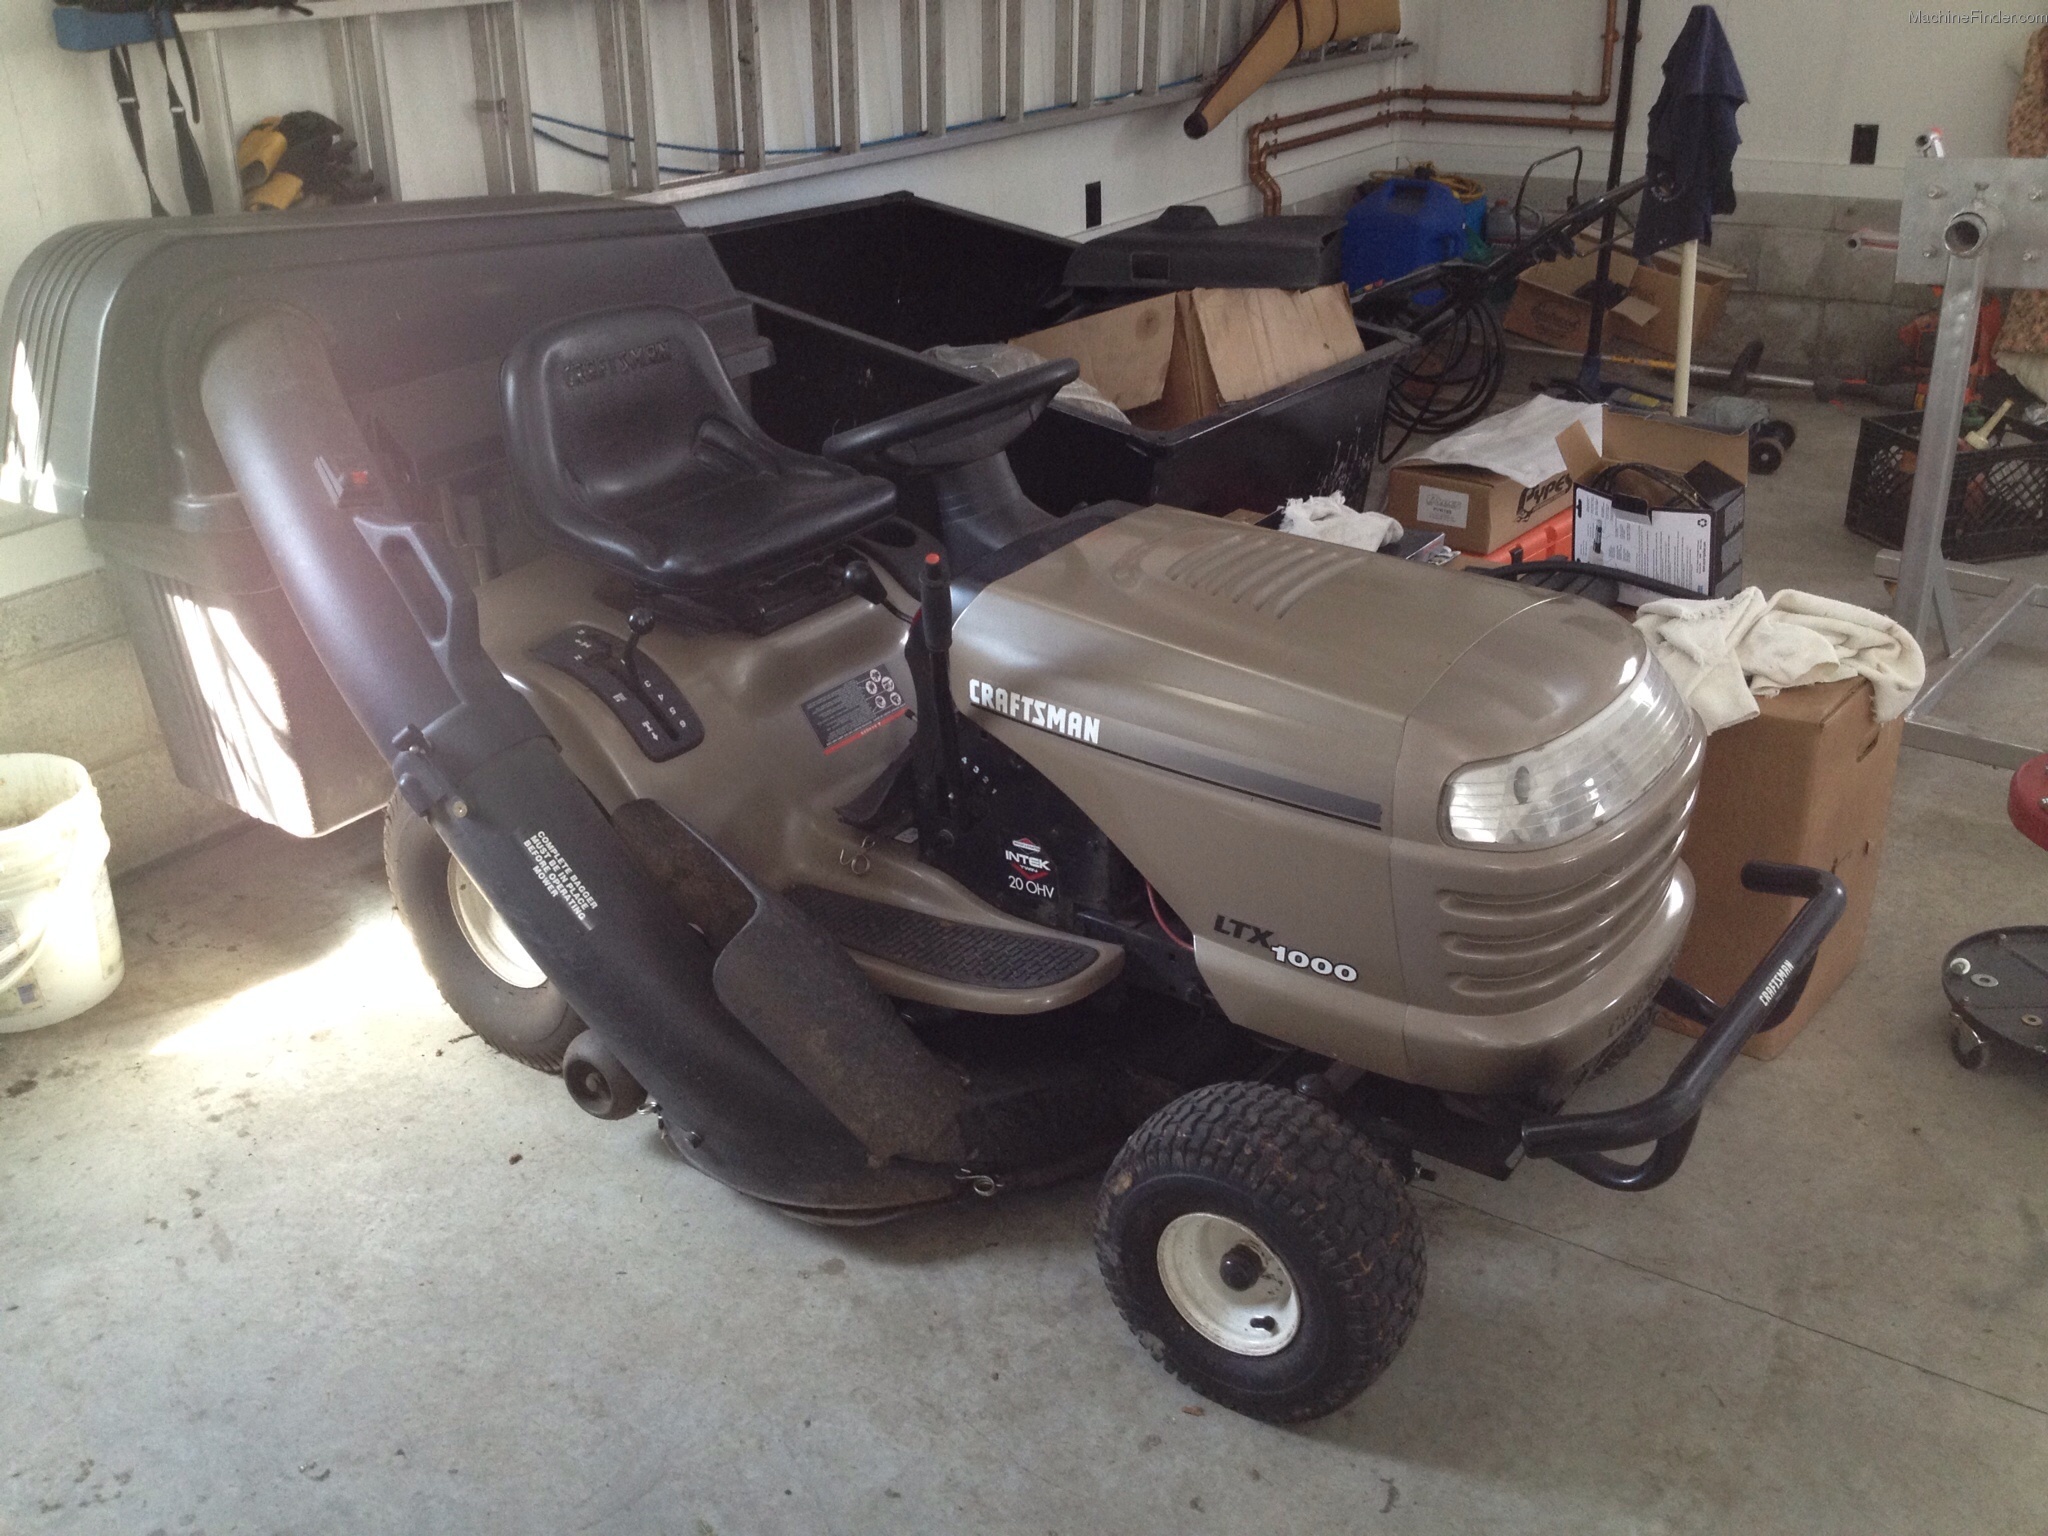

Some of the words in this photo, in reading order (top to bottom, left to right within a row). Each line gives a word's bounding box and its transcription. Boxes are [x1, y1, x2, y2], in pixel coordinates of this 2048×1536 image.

[969, 678, 1100, 744] CRAFTSMAN
[523, 840, 551, 873] BEFORE
[548, 873, 586, 920] OPERATING
[530, 835, 552, 859] MUST
[548, 859, 561, 872] BE
[558, 872, 568, 883] IN
[566, 882, 589, 911] PLACE
[532, 865, 559, 898] MOWER
[537, 831, 573, 875] COMPLETE
[570, 874, 598, 910] BAGGER
[1005, 850, 1051, 871] INTEK
[1008, 875, 1024, 891] 20
[1025, 880, 1054, 898] OHV
[1214, 914, 1274, 948] LTX
[1271, 944, 1358, 982] 1000
[1759, 959, 1795, 1006] CRAFTSMAN
